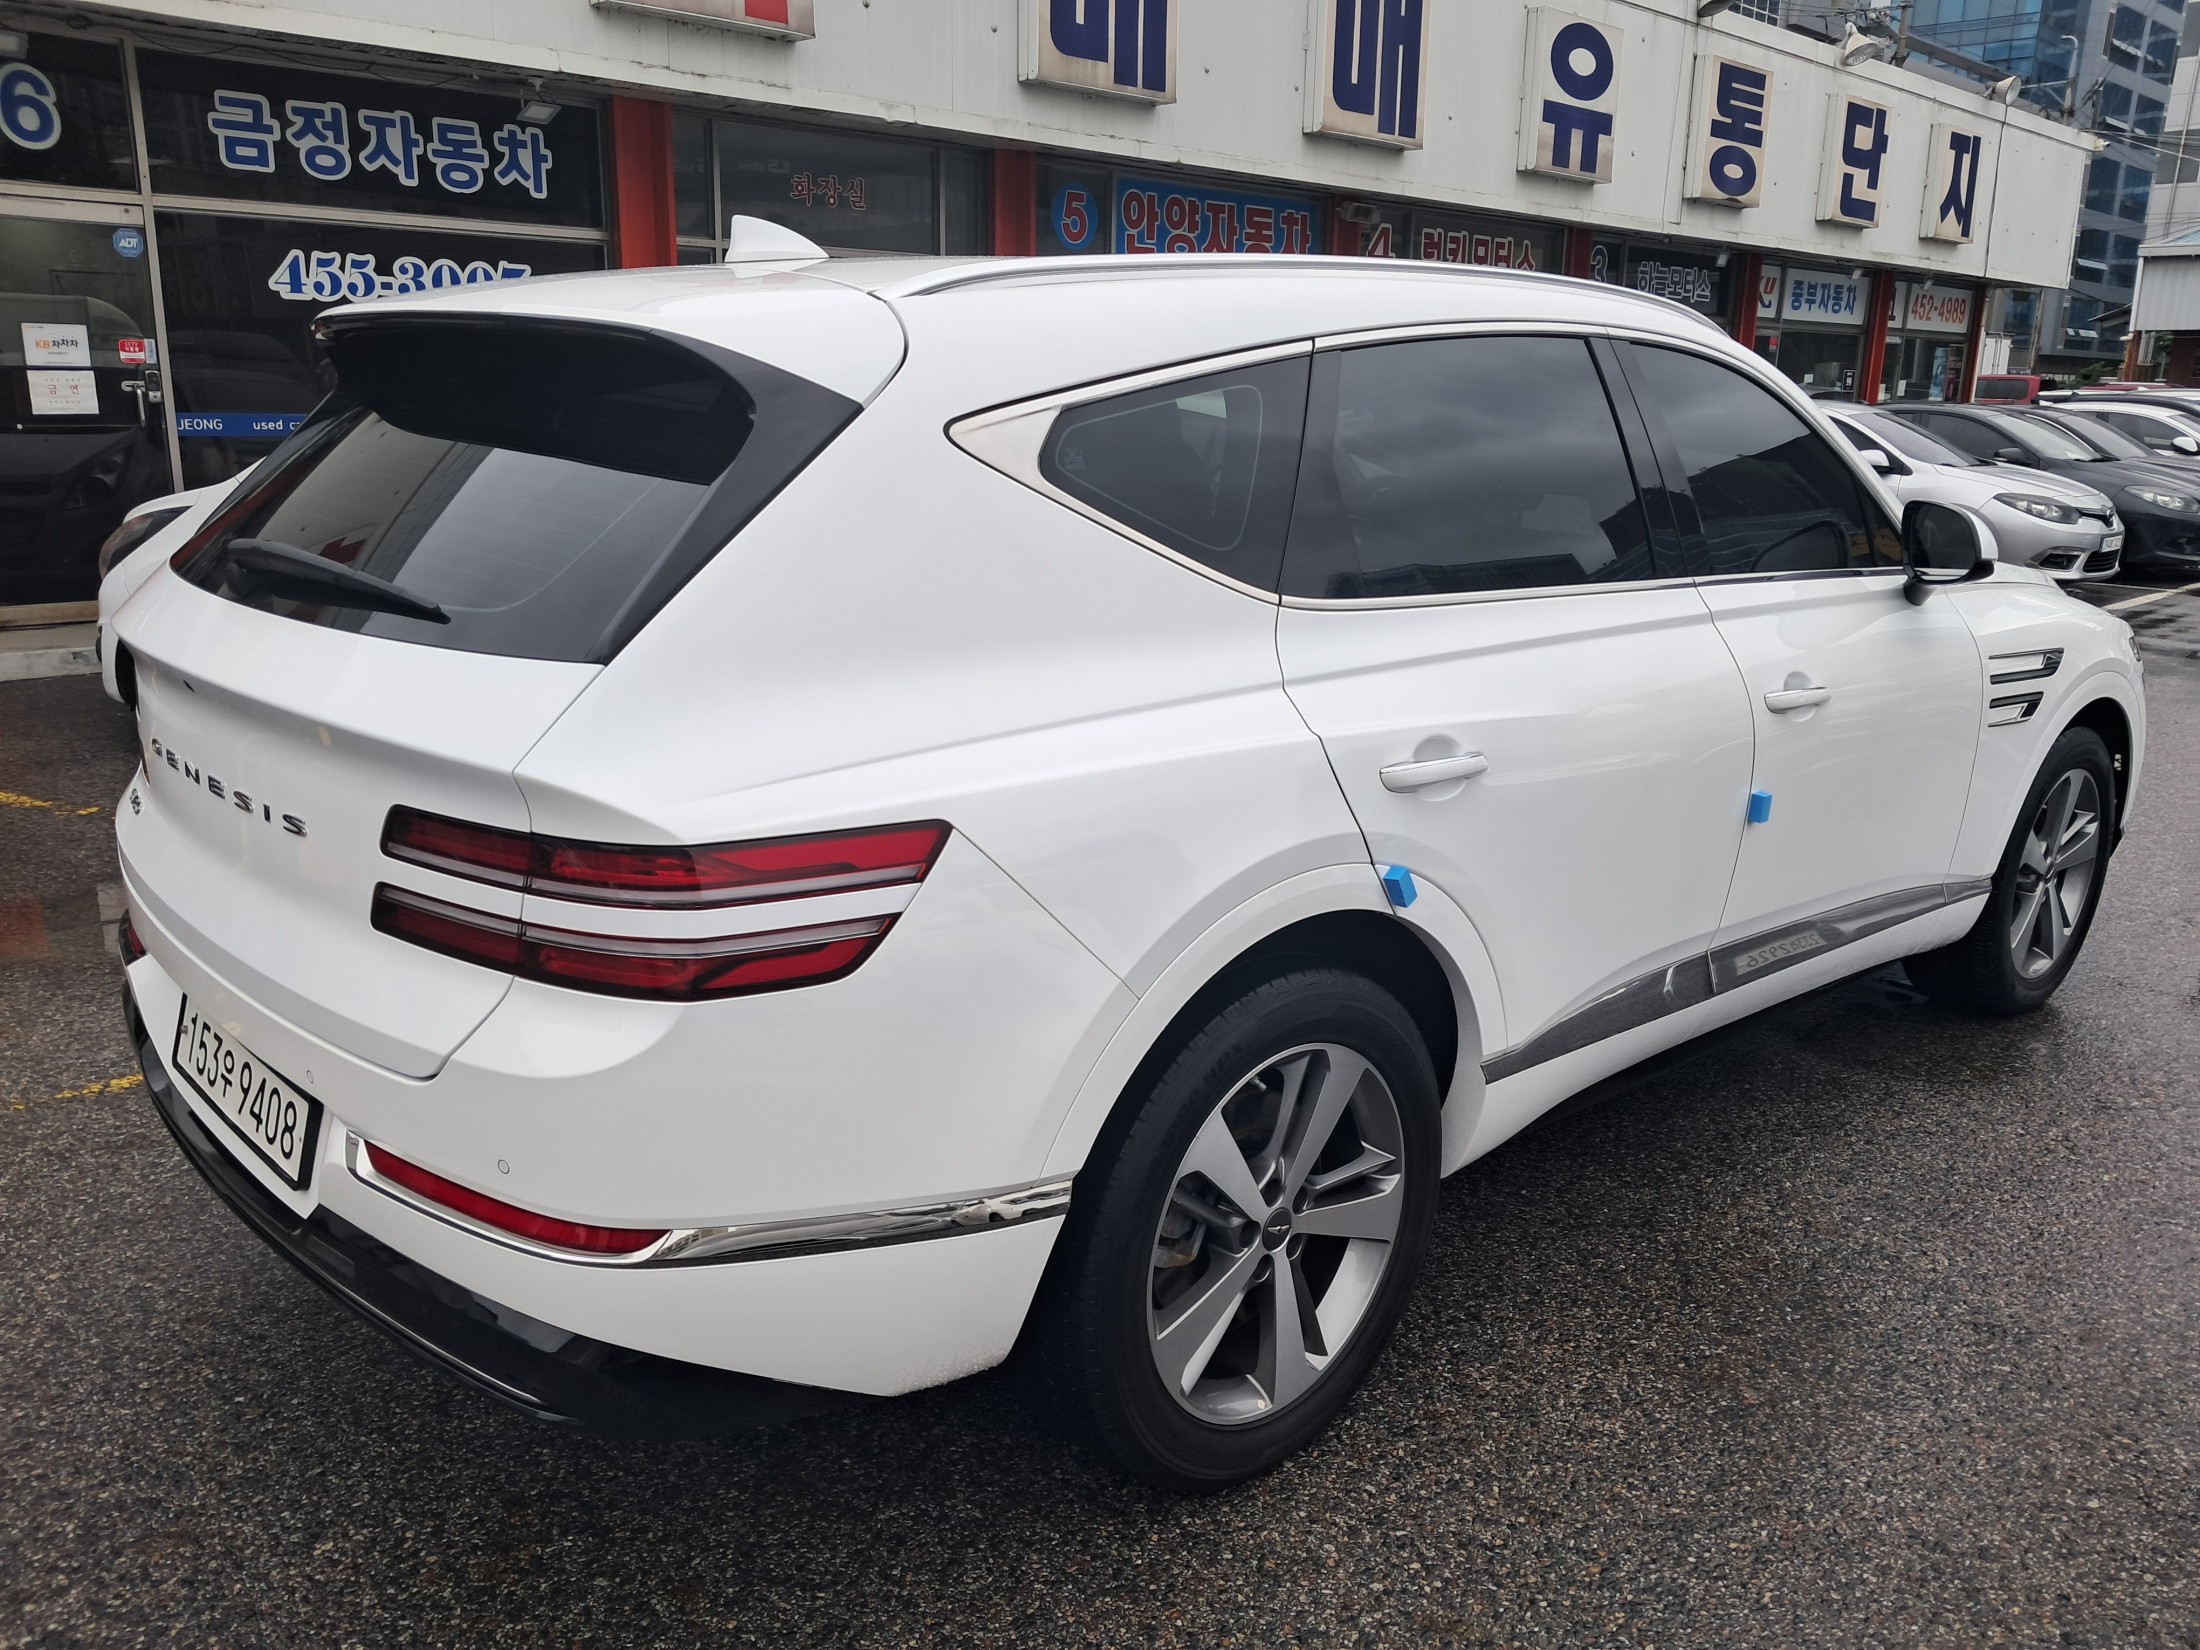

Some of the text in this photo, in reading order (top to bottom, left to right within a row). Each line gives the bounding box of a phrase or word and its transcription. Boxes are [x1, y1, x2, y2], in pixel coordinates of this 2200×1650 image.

[0, 62, 61, 150] 6
[208, 89, 552, 199] 금정자동차
[789, 172, 867, 211] 화장실
[1061, 189, 1089, 244] 5
[1122, 188, 1312, 255] 안양자동차
[119, 237, 138, 248] ADT
[1367, 222, 1396, 258] 4
[1637, 260, 1712, 303] 하늘모터스
[1791, 279, 1857, 316] 중부자동차
[1911, 293, 1967, 325] 452-4989
[35, 336, 79, 350] KB 차차차
[178, 418, 223, 431] JEONG
[253, 419, 284, 431] used
[151, 738, 308, 837] GENESIS
[237, 1061, 297, 1160] 9408
